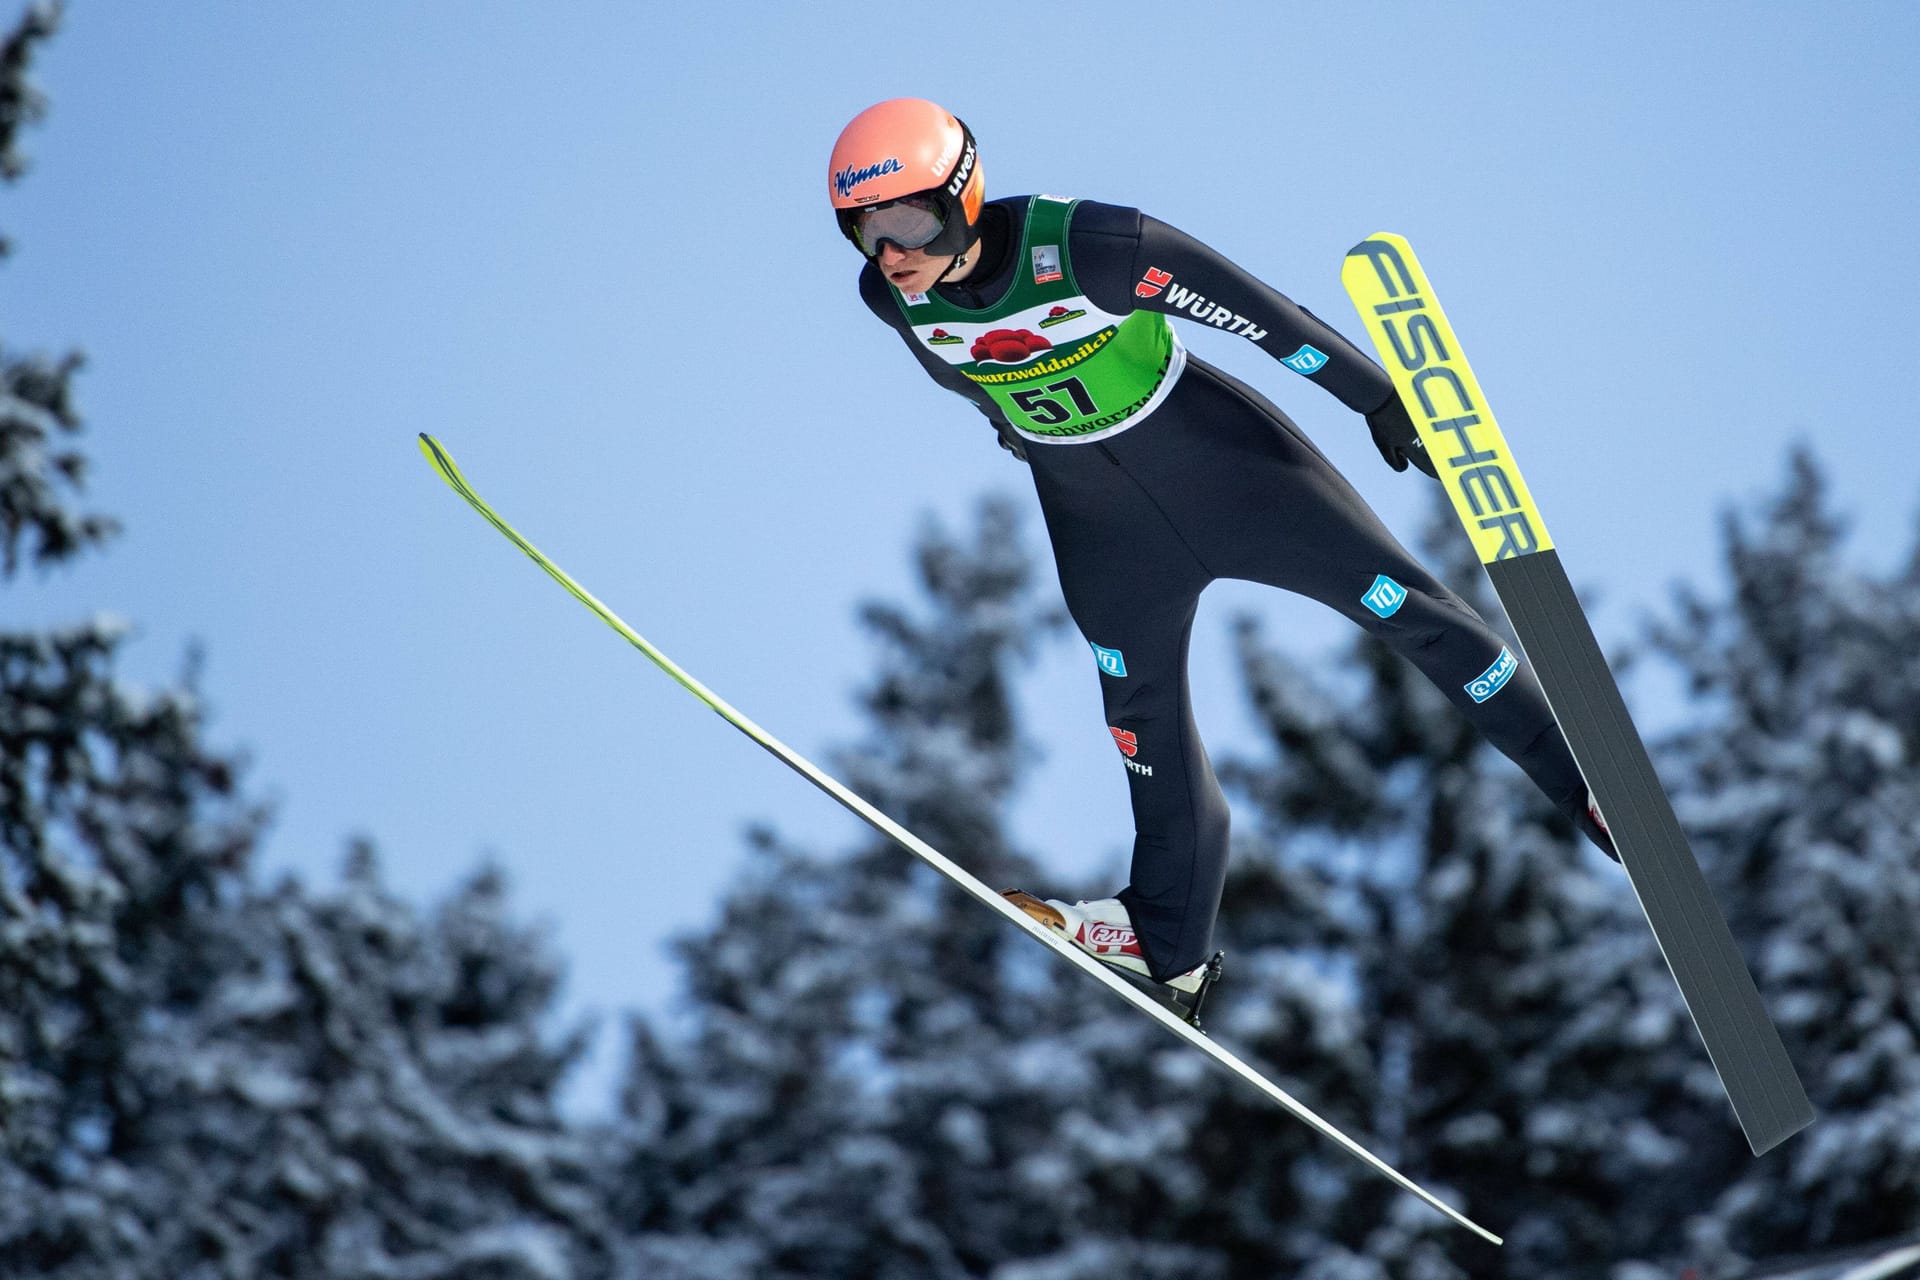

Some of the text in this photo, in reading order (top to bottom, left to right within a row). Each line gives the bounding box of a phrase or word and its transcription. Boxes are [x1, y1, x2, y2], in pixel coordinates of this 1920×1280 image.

[834, 158, 904, 197] Manner
[948, 141, 976, 196] uvex
[1009, 375, 1100, 426] 57
[1345, 240, 1539, 562] FISCHER
[1123, 755, 1152, 776] RTH
